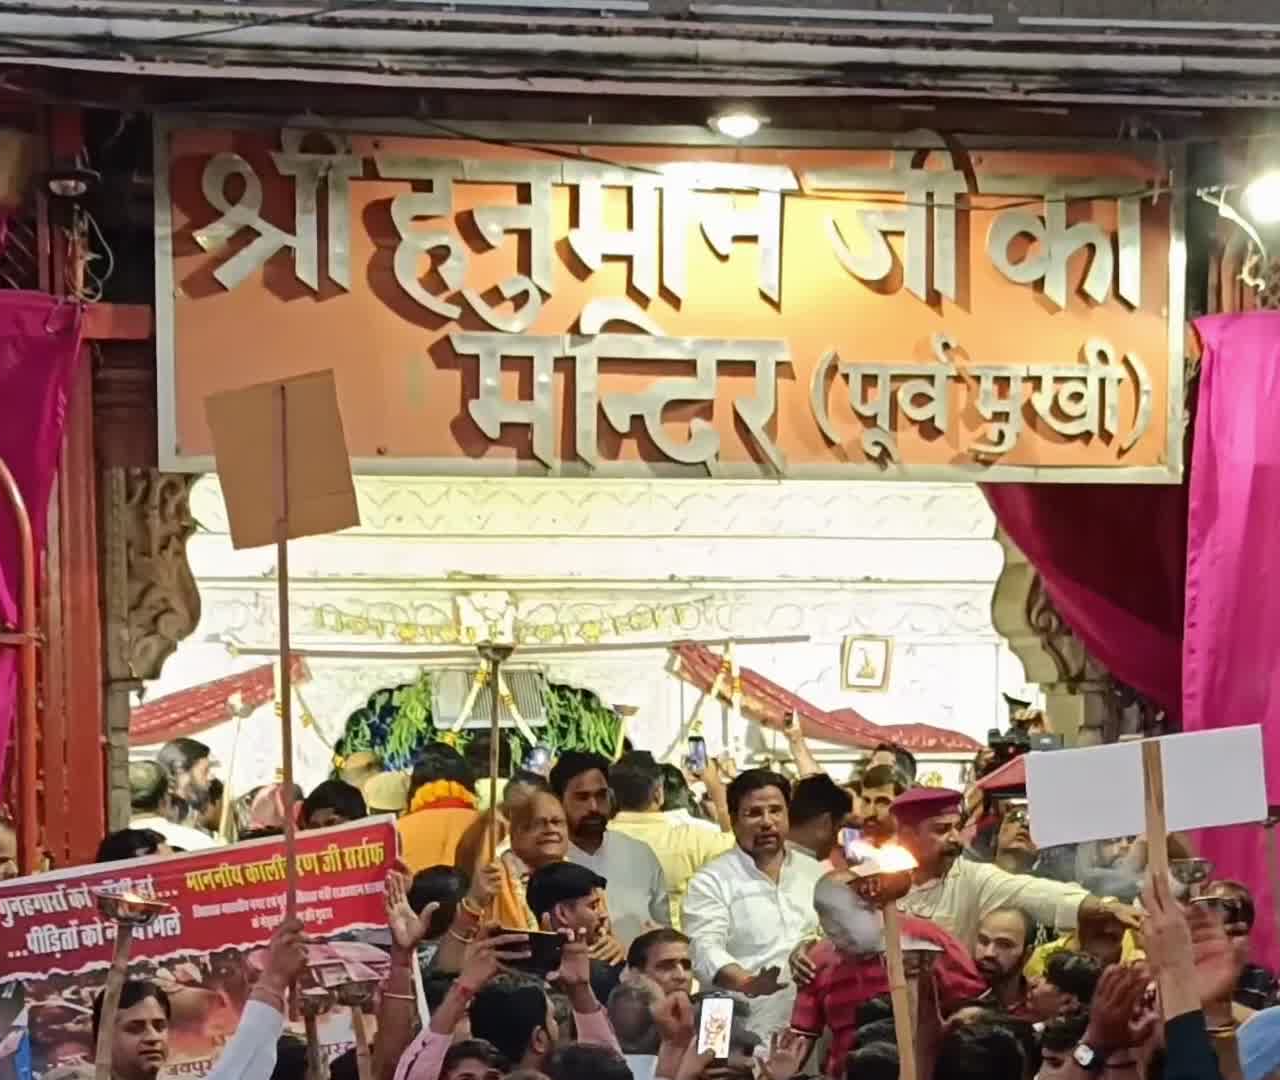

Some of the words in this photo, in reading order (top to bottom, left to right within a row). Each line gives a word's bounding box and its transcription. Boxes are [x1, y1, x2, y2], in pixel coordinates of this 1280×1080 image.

[191, 128, 358, 292] श्री
[358, 156, 799, 332] हनुमान
[803, 130, 978, 305] जी
[978, 175, 1166, 307] का
[451, 302, 789, 476] मन्दिर
[966, 340, 1153, 456] मुखी)
[184, 863, 245, 892] माननीय
[245, 852, 320, 885] कालीरण
[322, 844, 344, 874] जी
